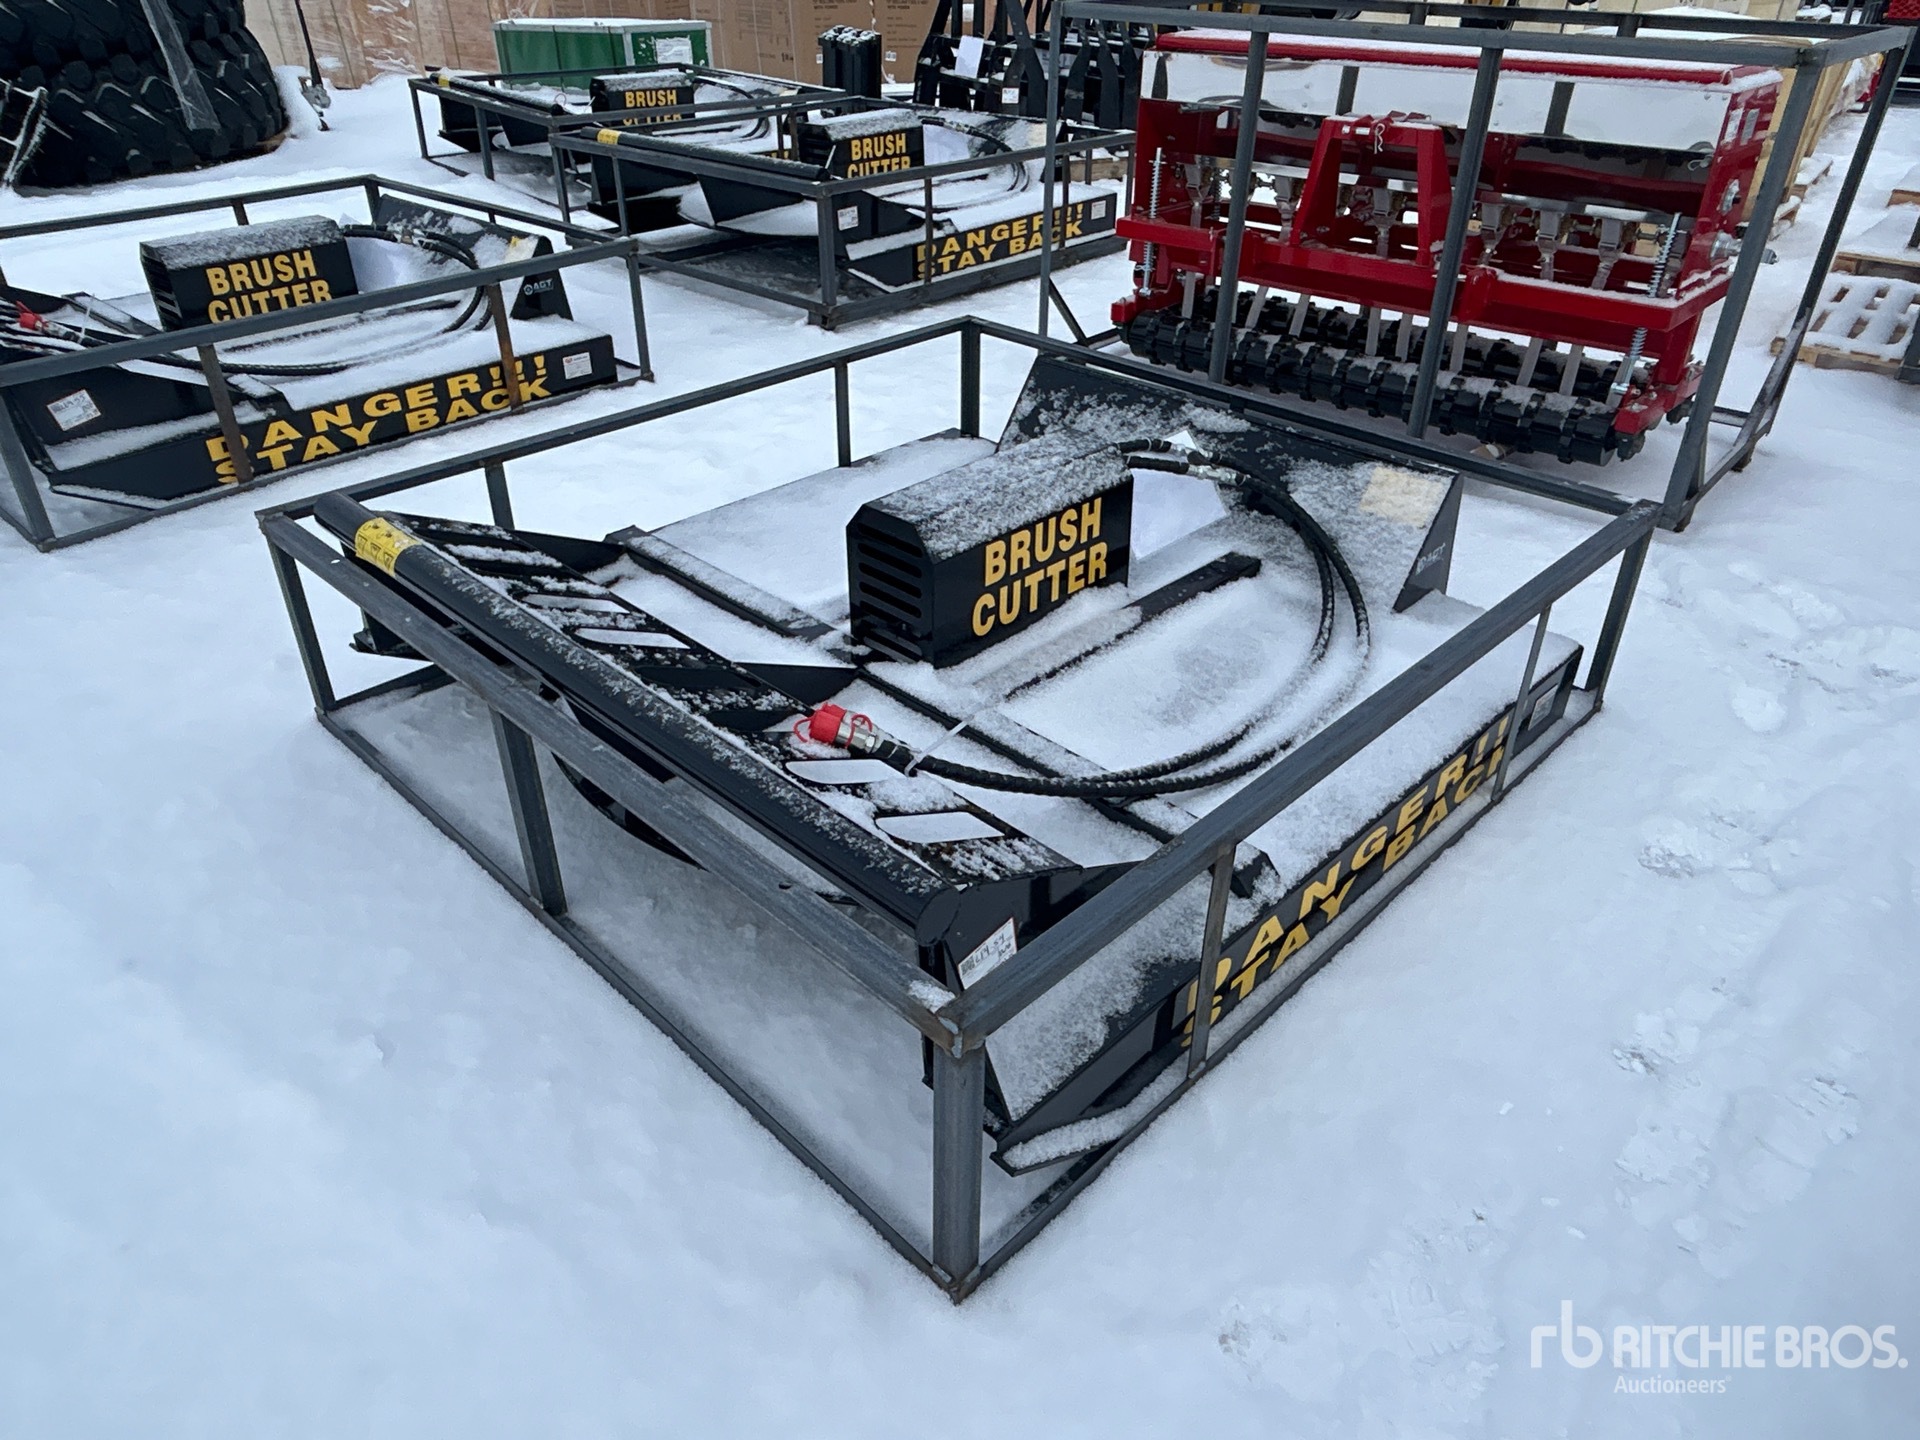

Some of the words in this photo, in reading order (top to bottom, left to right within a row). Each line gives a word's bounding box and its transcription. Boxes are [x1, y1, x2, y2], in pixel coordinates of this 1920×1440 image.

[625, 89, 677, 108] BRUSH
[851, 133, 907, 161] BRUSH
[206, 249, 317, 296] BRUSH
[207, 279, 333, 325] CUTTER
[405, 376, 552, 433] BACK
[984, 496, 1103, 587] BRUSH
[971, 541, 1108, 637] CUTTER
